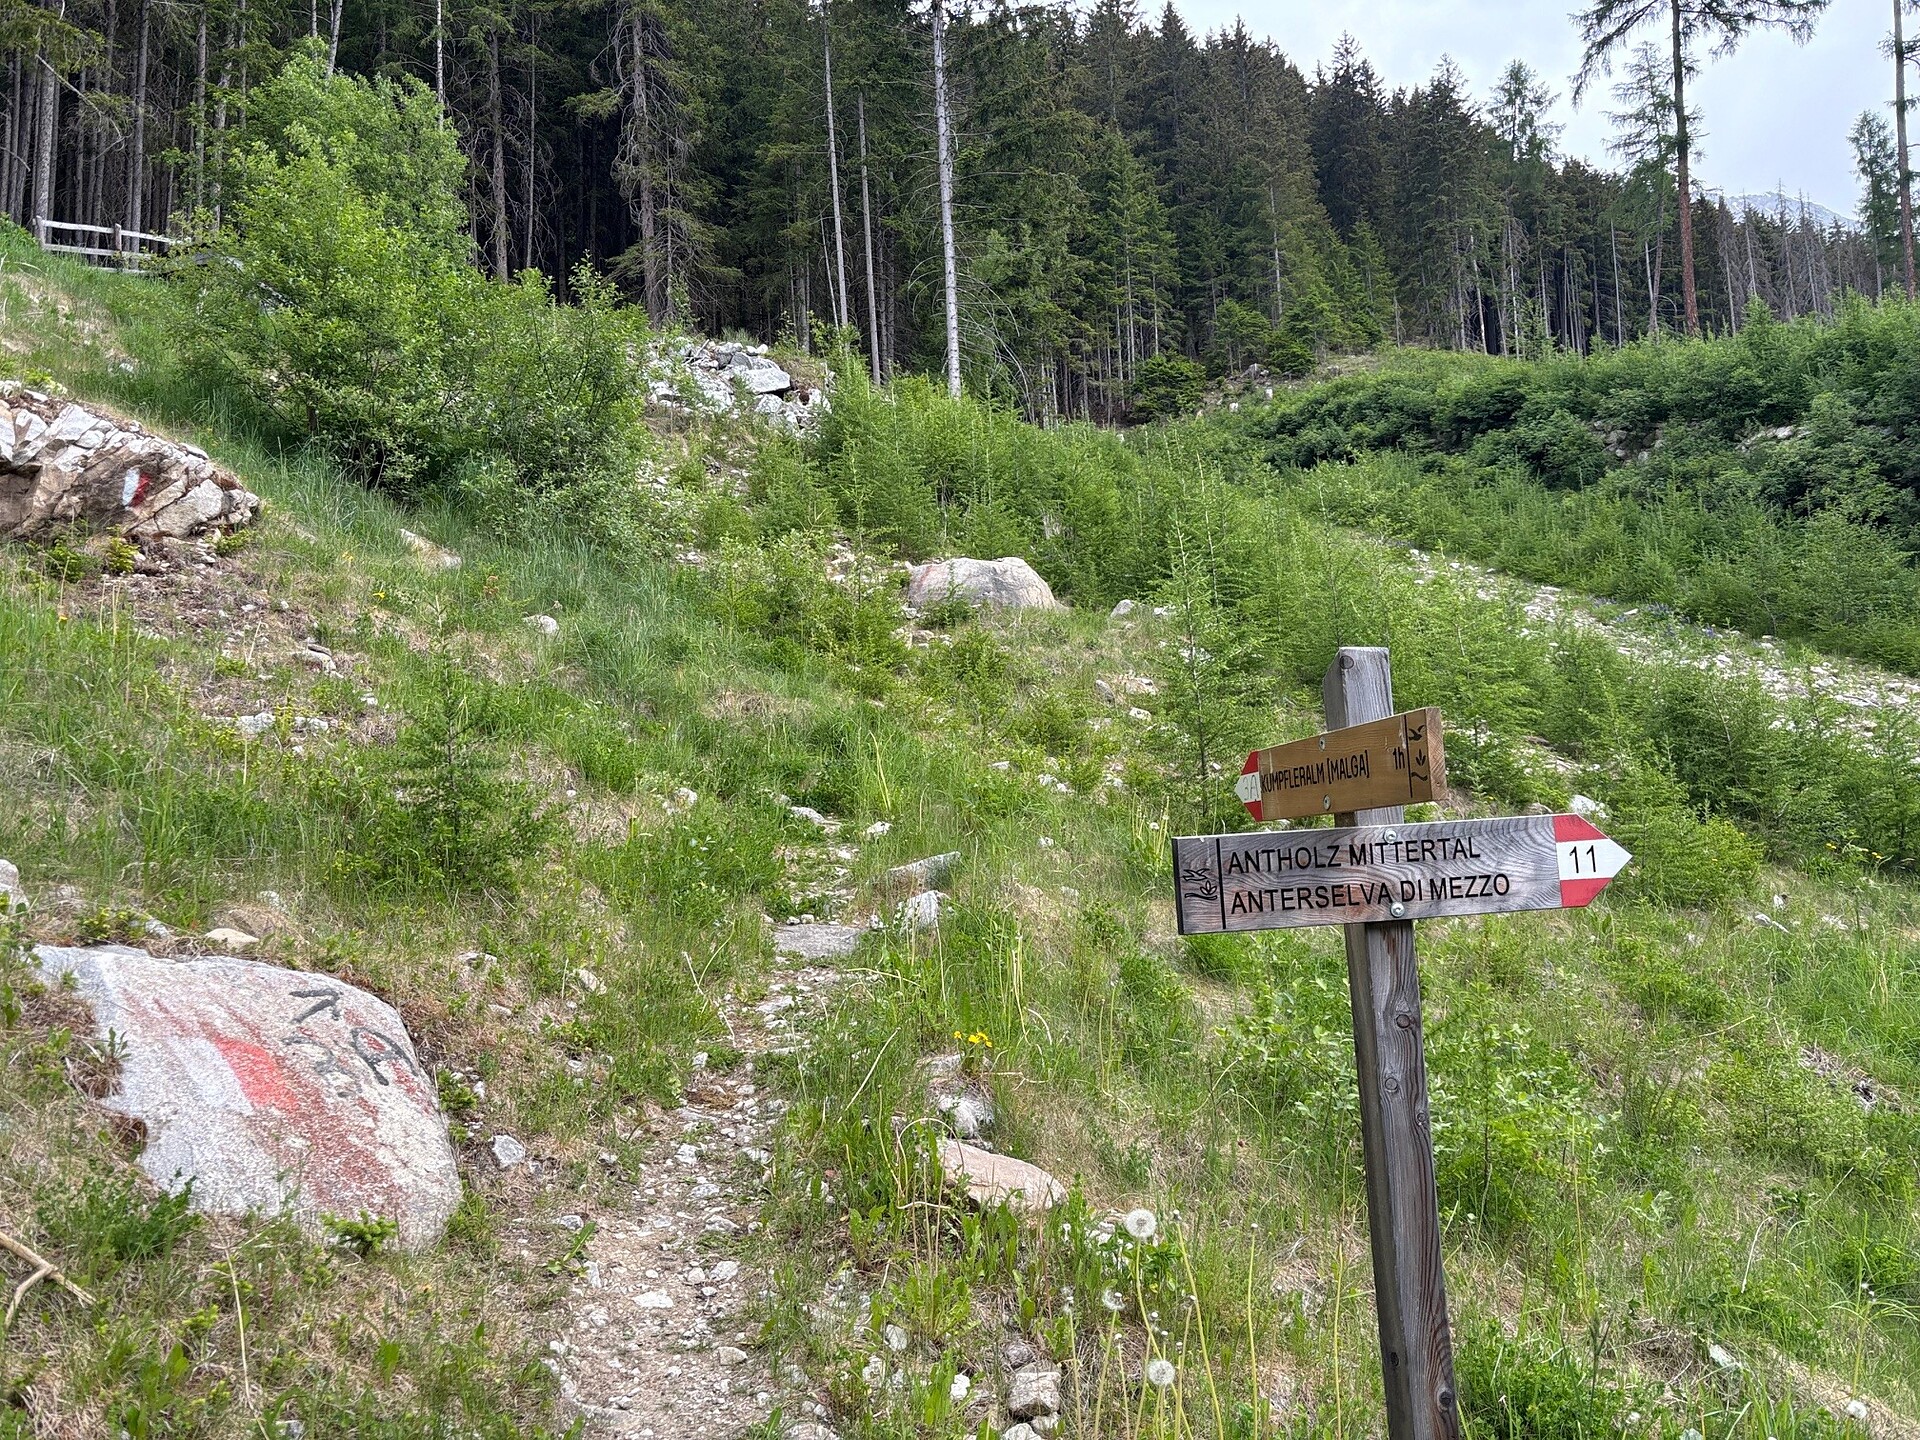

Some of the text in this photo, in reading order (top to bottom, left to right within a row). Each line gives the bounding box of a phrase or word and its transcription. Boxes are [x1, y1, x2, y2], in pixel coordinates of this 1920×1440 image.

[1260, 747, 1405, 793] KUMPFLERALM [MALGA] 1h
[1227, 836, 1481, 875] ANTHOLZ MITTERTAL
[1569, 846, 1597, 874] 11
[1231, 873, 1509, 915] ANTERSELVA DI MEZZO
